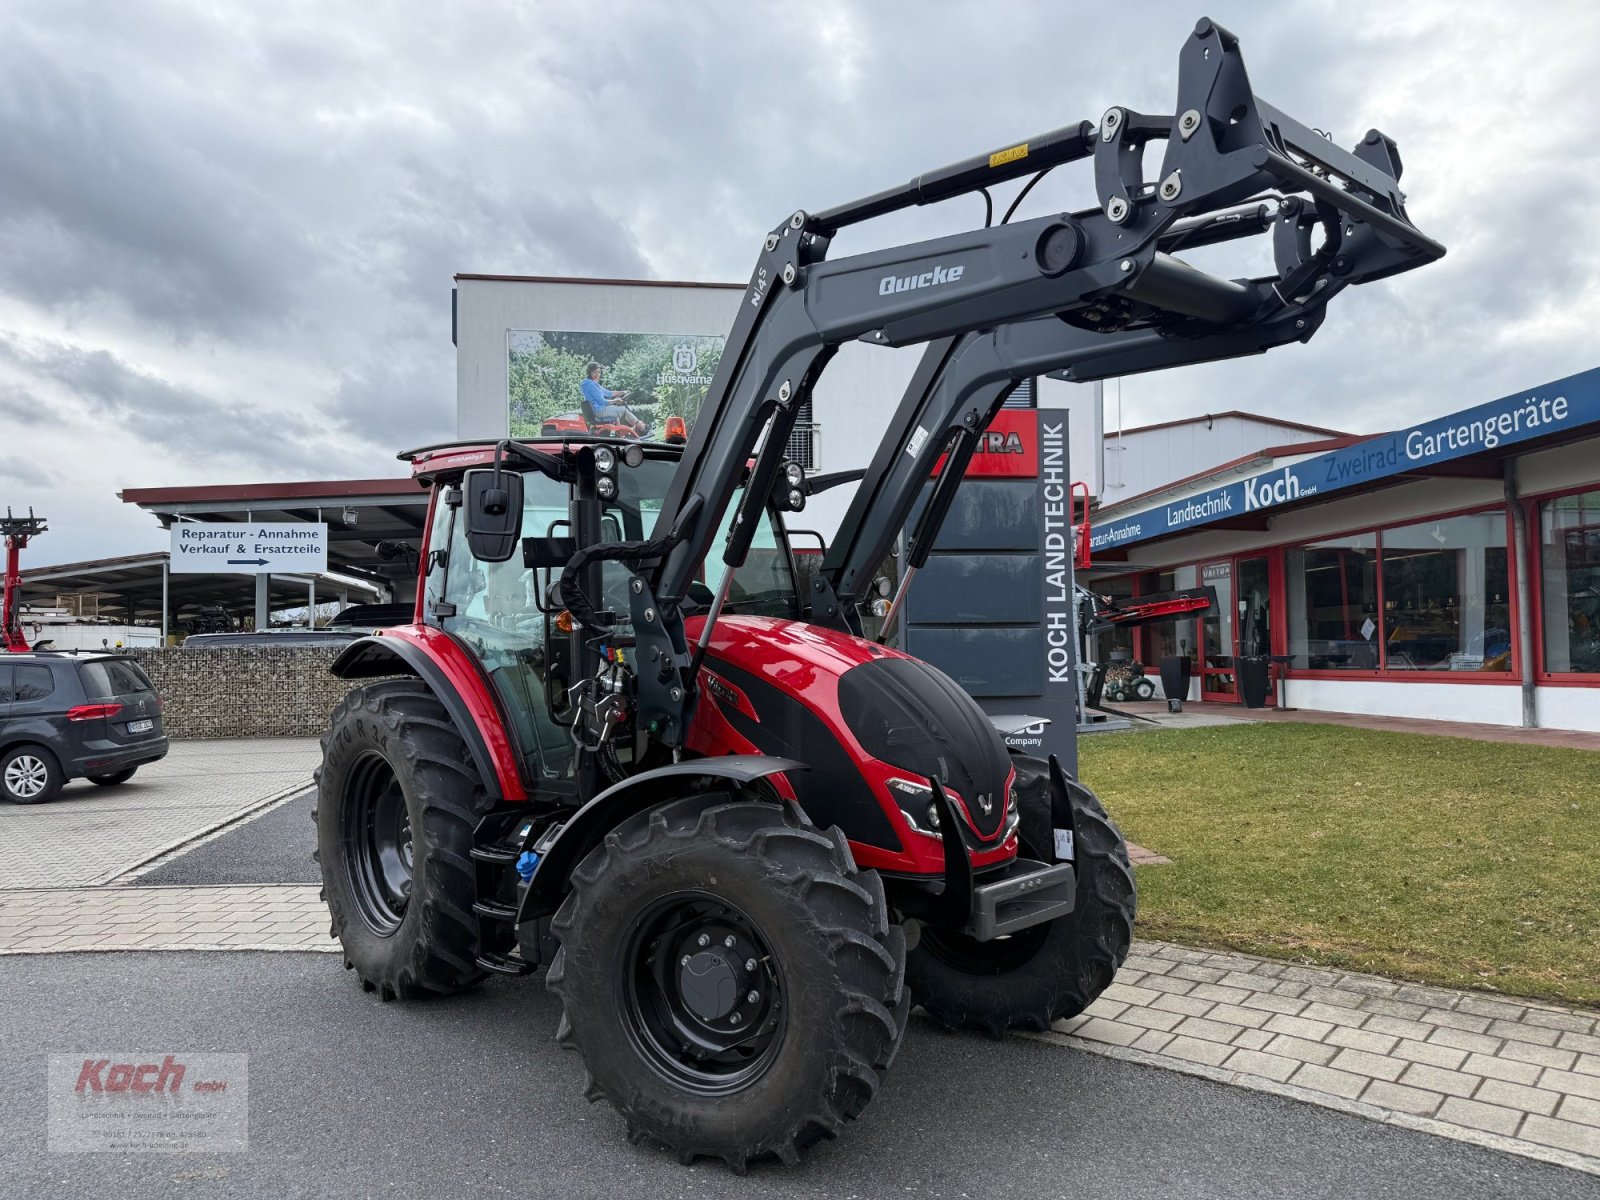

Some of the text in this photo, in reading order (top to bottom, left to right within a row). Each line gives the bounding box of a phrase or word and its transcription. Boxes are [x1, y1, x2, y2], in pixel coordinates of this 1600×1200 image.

[879, 265, 964, 296] Quicke
[657, 373, 713, 385] Husqvarna
[1167, 490, 1232, 526] Landtechnik
[1244, 467, 1300, 511] Koch
[1300, 485, 1317, 497] GmbH
[1406, 396, 1568, 460] Gartengeräte
[182, 528, 246, 541] Reparatur
[258, 529, 319, 539] Annahme
[180, 543, 321, 554] Verkauf & Ersatzteile
[1043, 422, 1068, 682] KOCH LANDTECHNIK
[1005, 736, 1042, 747] Company
